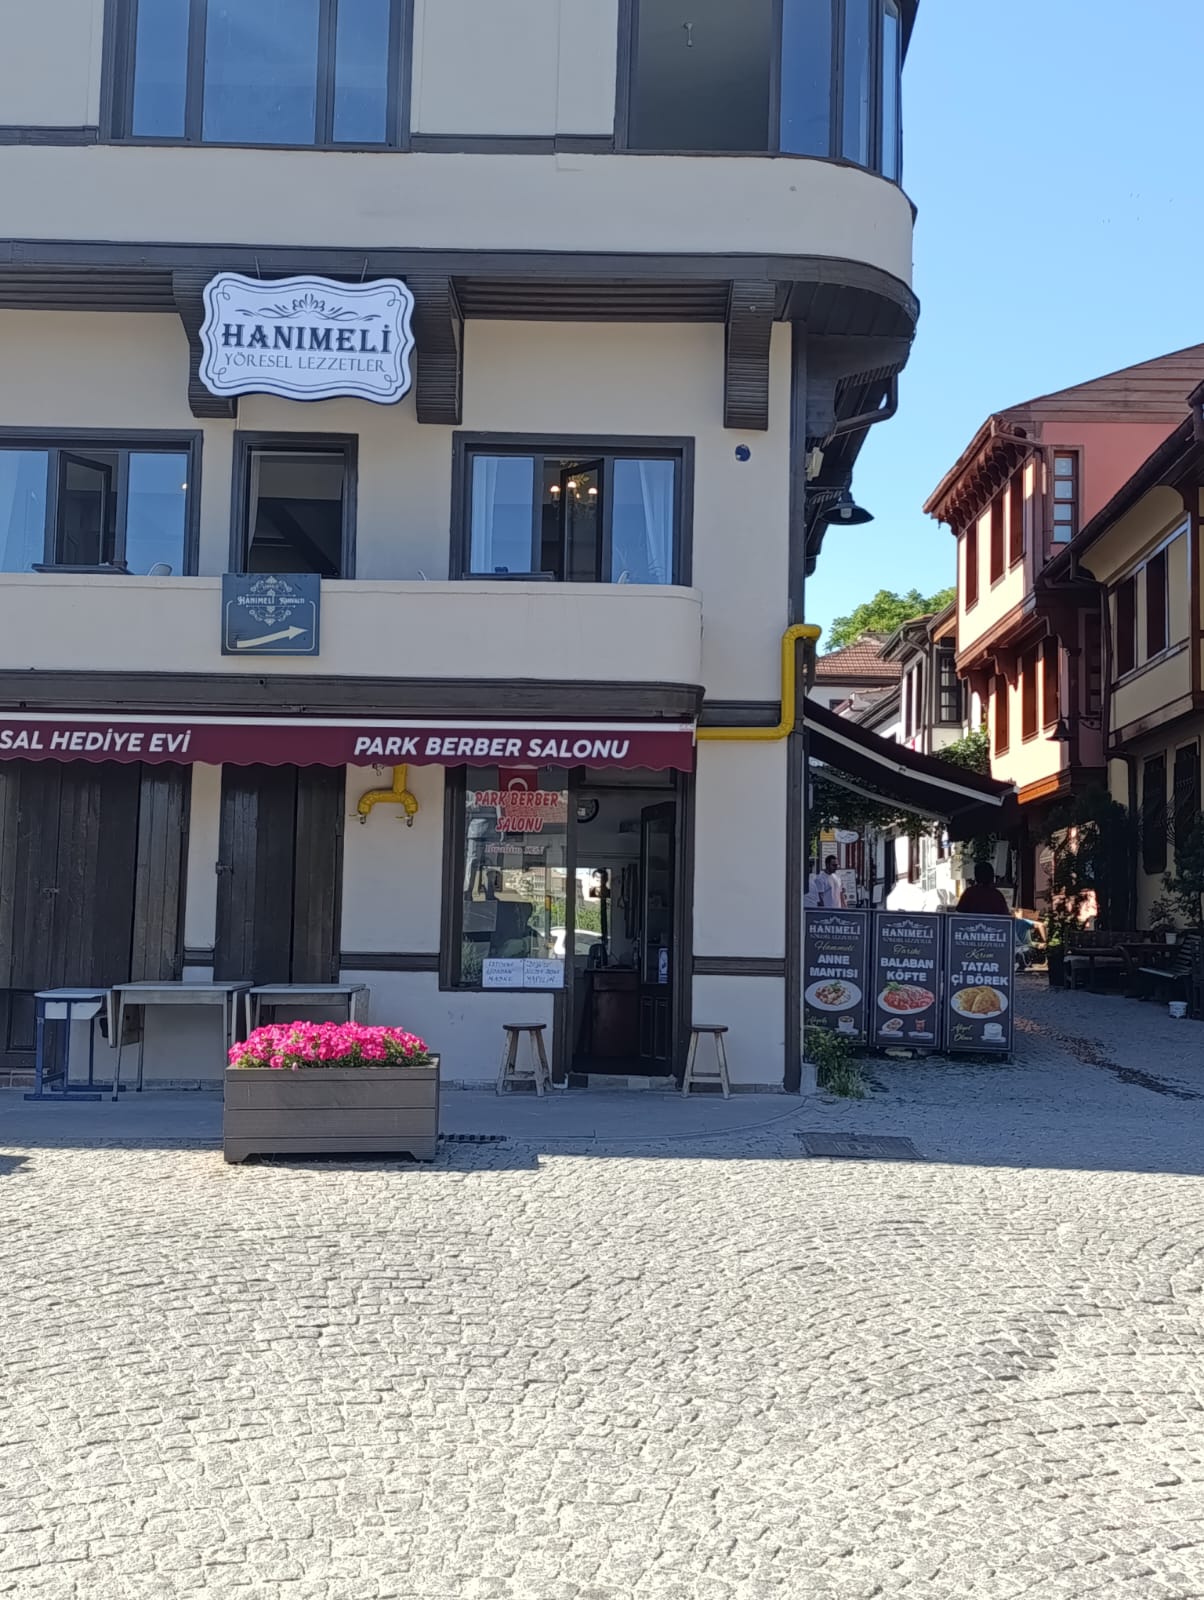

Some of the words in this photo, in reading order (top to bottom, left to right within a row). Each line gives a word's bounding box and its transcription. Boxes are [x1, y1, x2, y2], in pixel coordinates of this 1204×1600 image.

[221, 323, 393, 354] HANIMELİ
[224, 352, 293, 369] YÖRESEL
[298, 356, 386, 373] LEZZETLER
[0, 730, 44, 750] SAL
[50, 728, 145, 752] HEDİYE
[149, 730, 192, 752] EVİ
[354, 737, 420, 756] PARK
[424, 737, 522, 757] BERBER
[526, 739, 629, 759] SALONU
[474, 791, 508, 807] PARK
[510, 791, 559, 808] BERBER
[495, 817, 544, 833] SALONU
[817, 954, 850, 965] ANNE
[880, 957, 934, 969] BALABAN
[961, 961, 1000, 973] TATAR
[809, 966, 859, 979] MANTISI
[886, 968, 928, 982] KÖFTE
